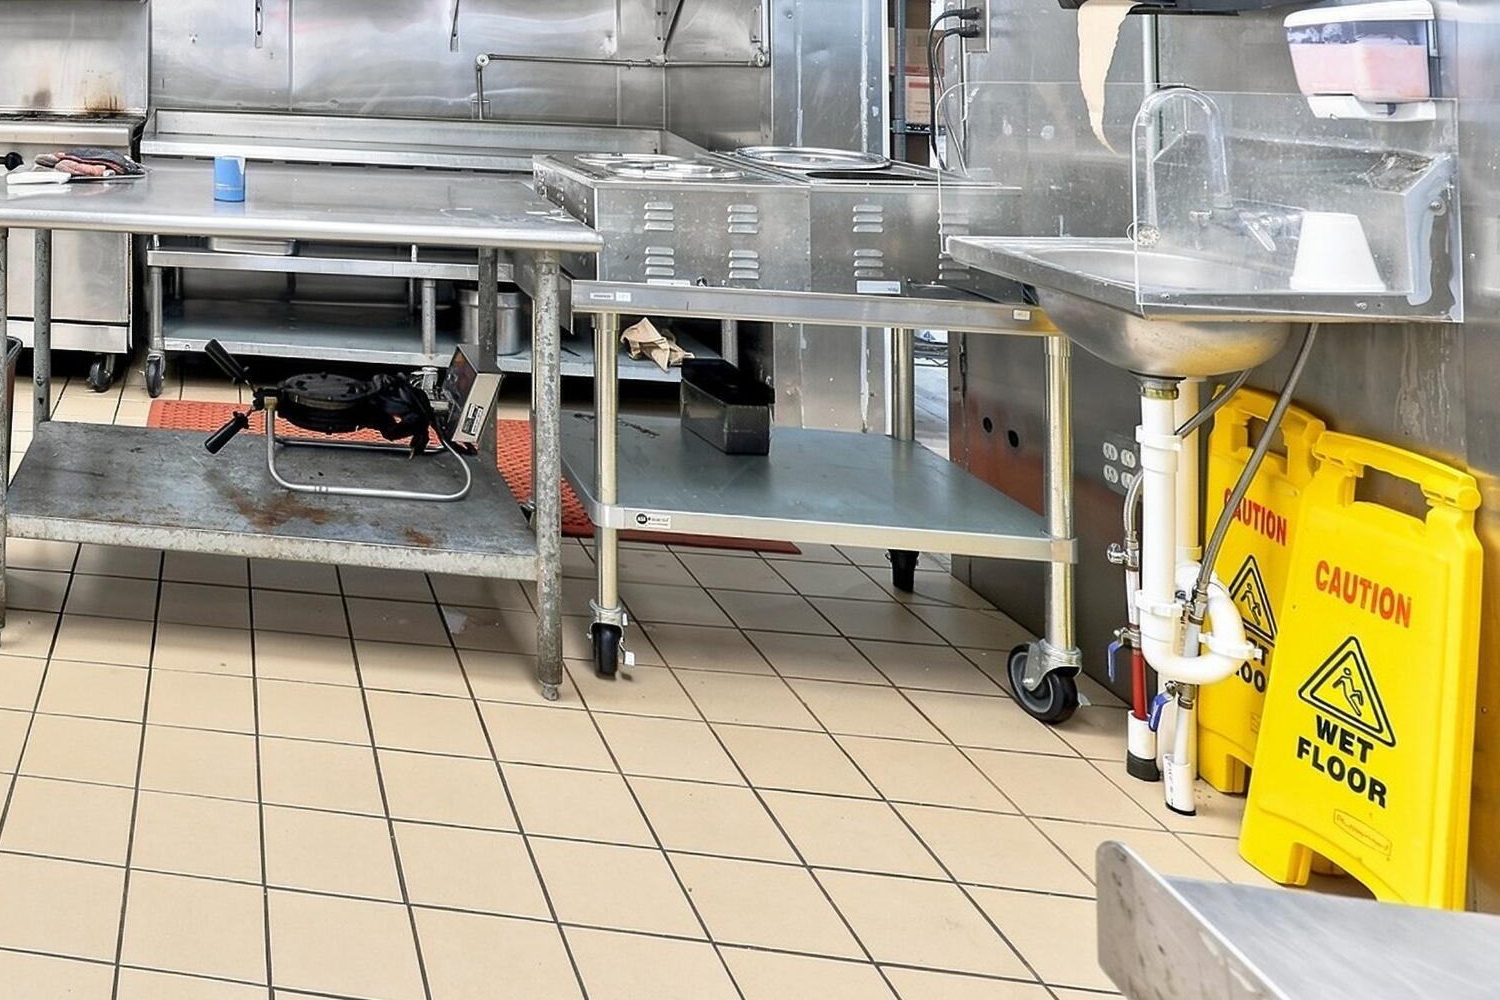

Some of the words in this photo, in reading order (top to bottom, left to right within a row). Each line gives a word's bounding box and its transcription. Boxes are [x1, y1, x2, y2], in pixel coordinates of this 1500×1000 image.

[1315, 560, 1413, 628] CAUTION
[1297, 736, 1388, 808] FLOOR
[1315, 715, 1374, 764] WET
